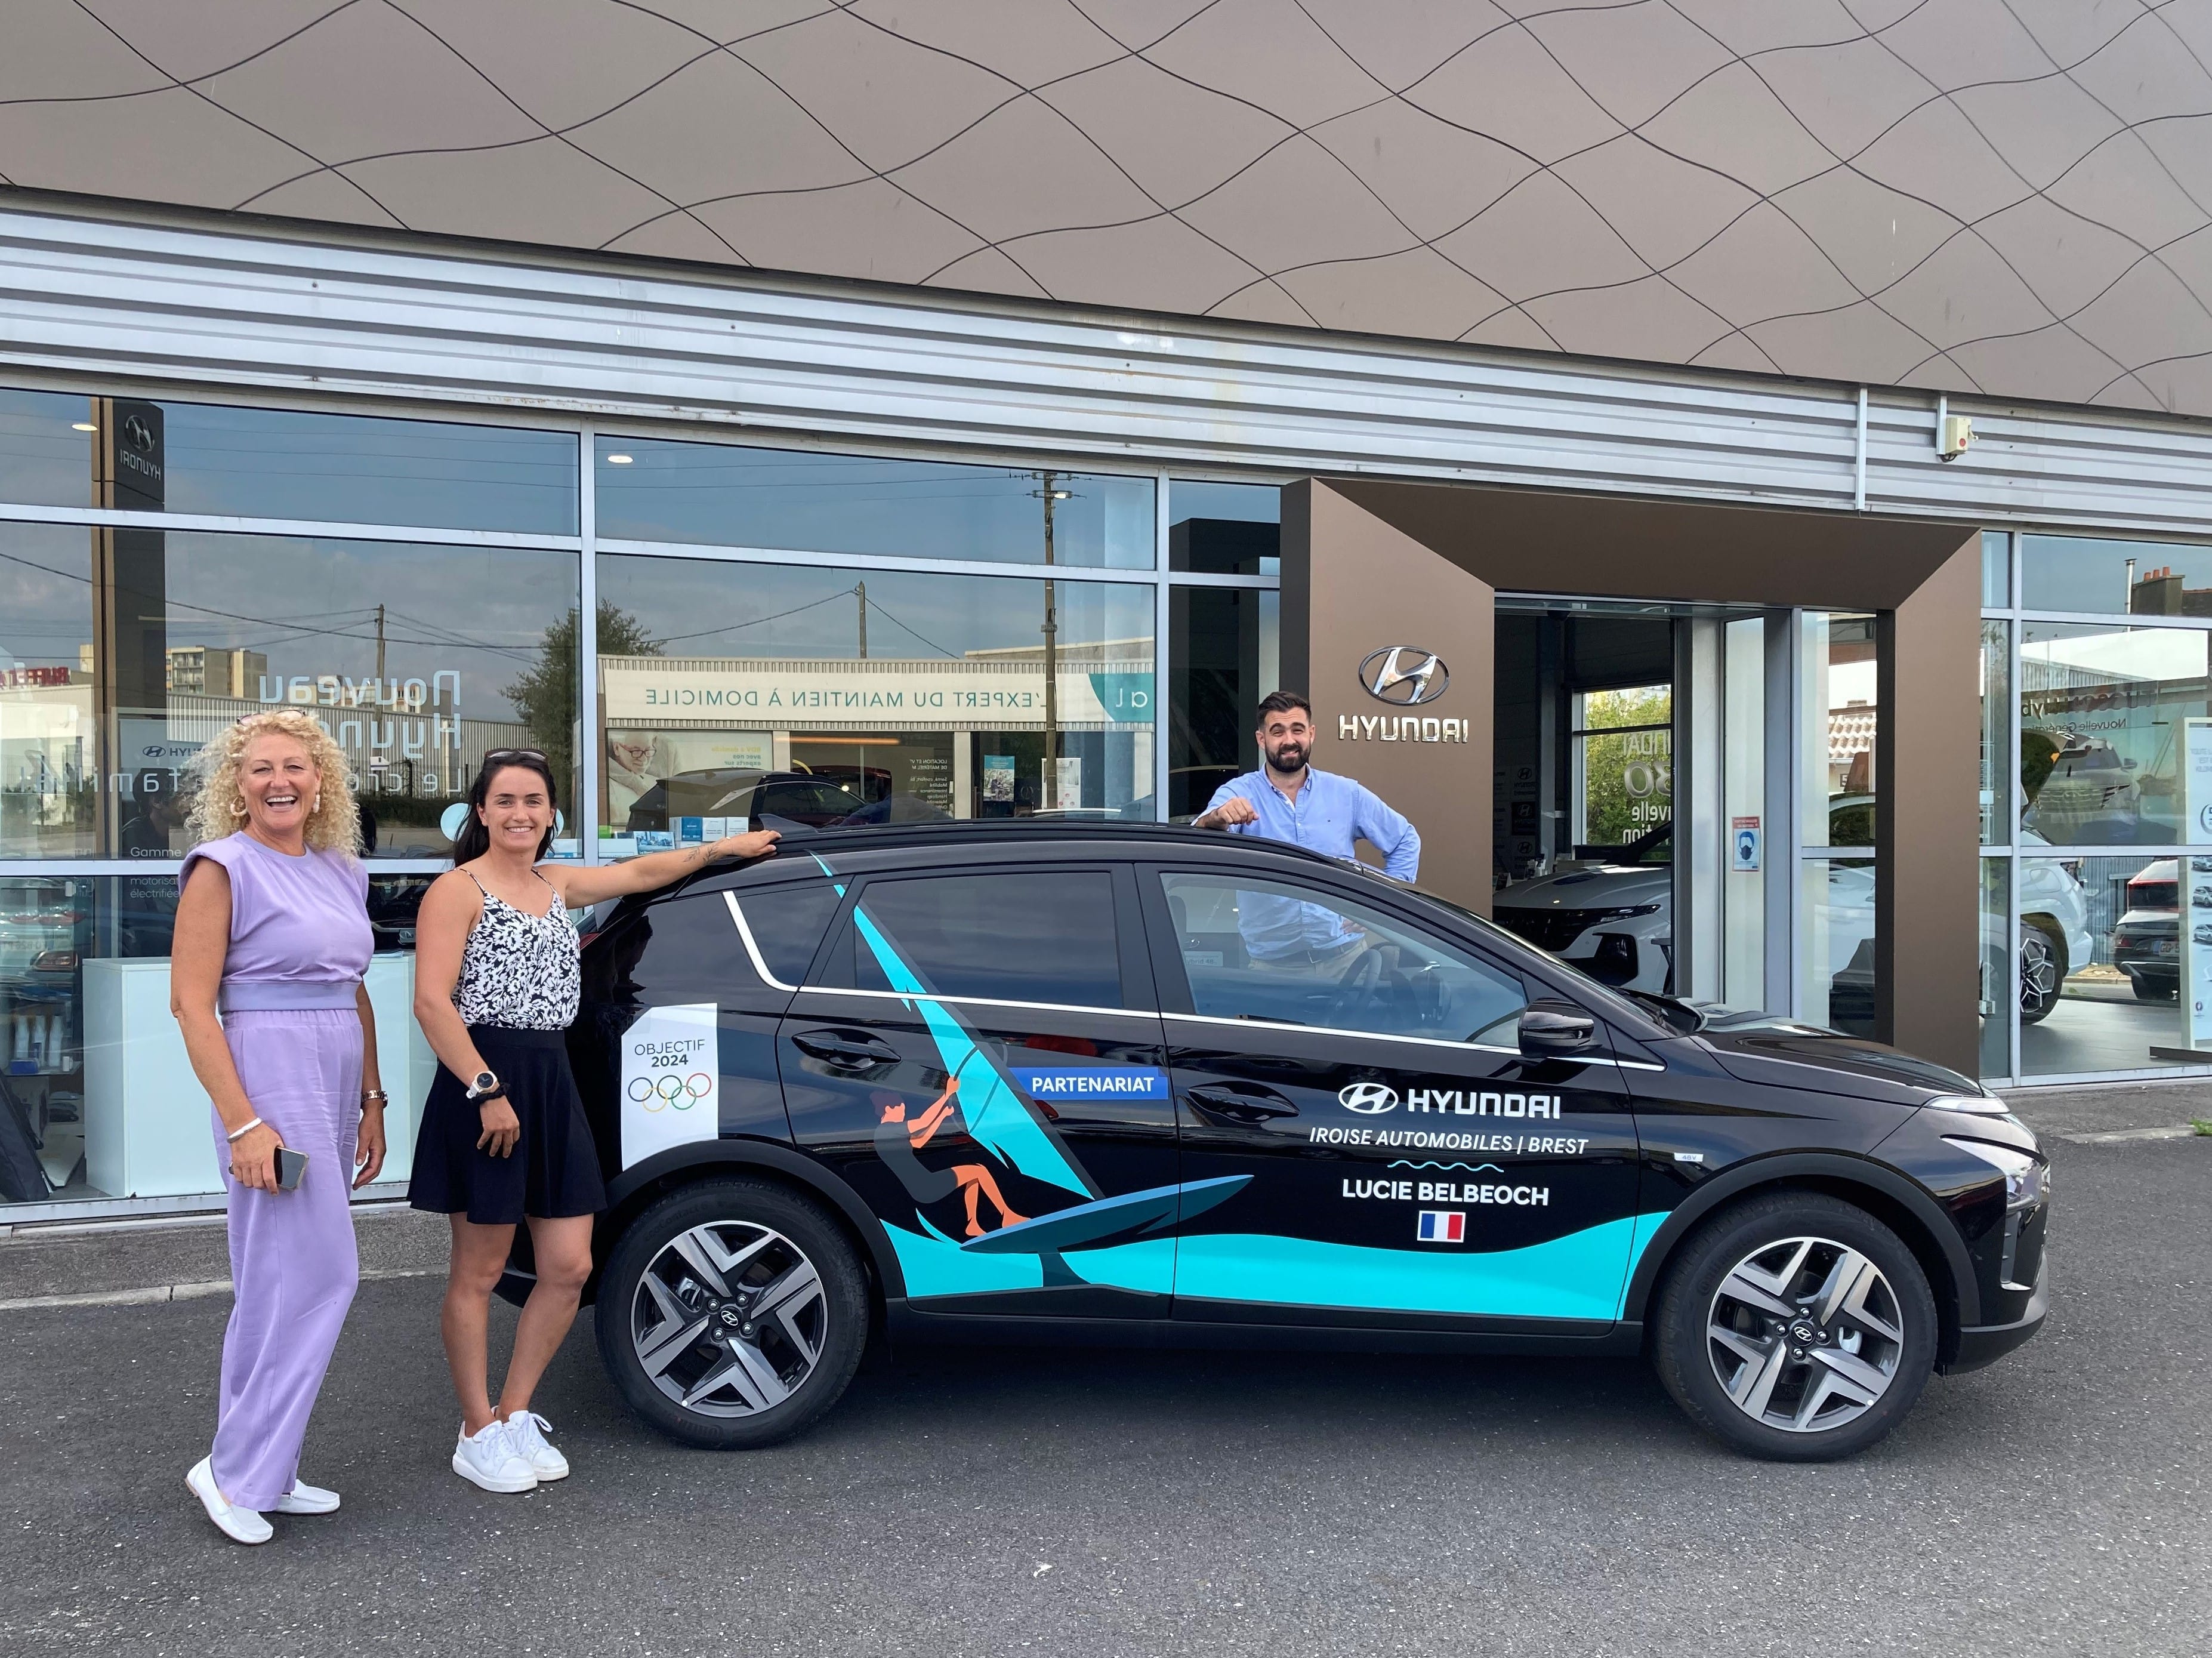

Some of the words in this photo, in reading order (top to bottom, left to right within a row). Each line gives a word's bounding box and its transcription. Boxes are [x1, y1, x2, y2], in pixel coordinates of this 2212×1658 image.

[1338, 714, 1469, 744] HYUNDAI
[130, 847, 182, 857] Gamme
[130, 888, 180, 898] électrifiée
[634, 1038, 706, 1056] OBJECTIF
[651, 1054, 689, 1068] 2024
[1032, 1077, 1155, 1093] PARTENARIAT
[1407, 1088, 1561, 1120] HYUNDAI
[1309, 1127, 1373, 1145] IROISE
[1375, 1130, 1513, 1152] AUTOMOBILES
[1528, 1137, 1589, 1155] BREST
[1342, 1178, 1413, 1200] LUCIE
[1418, 1183, 1550, 1207] BELBEOCH
